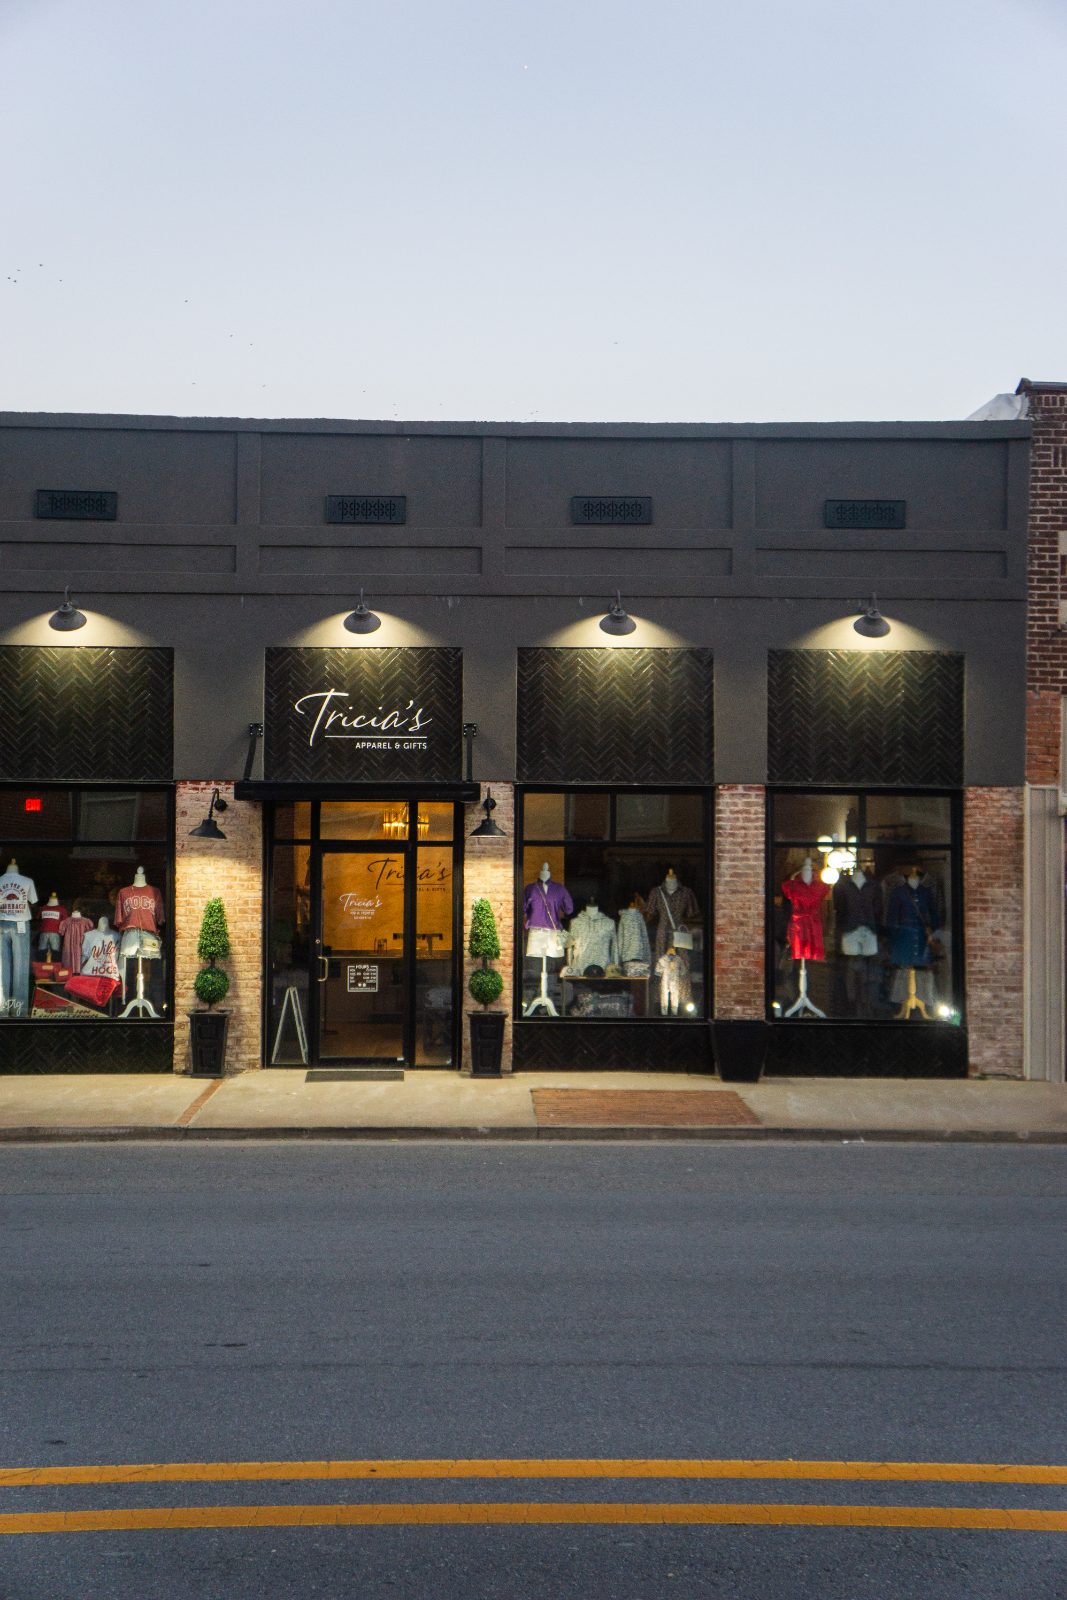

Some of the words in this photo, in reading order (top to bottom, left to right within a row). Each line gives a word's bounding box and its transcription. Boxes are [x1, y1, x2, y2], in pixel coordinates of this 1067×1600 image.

[294, 688, 433, 747] Tricia's
[403, 742, 427, 750] GIFTS
[367, 857, 452, 890] Tria's
[123, 895, 156, 916] HOGS
[339, 892, 383, 912] Tricia's
[91, 965, 117, 974] HOGS
